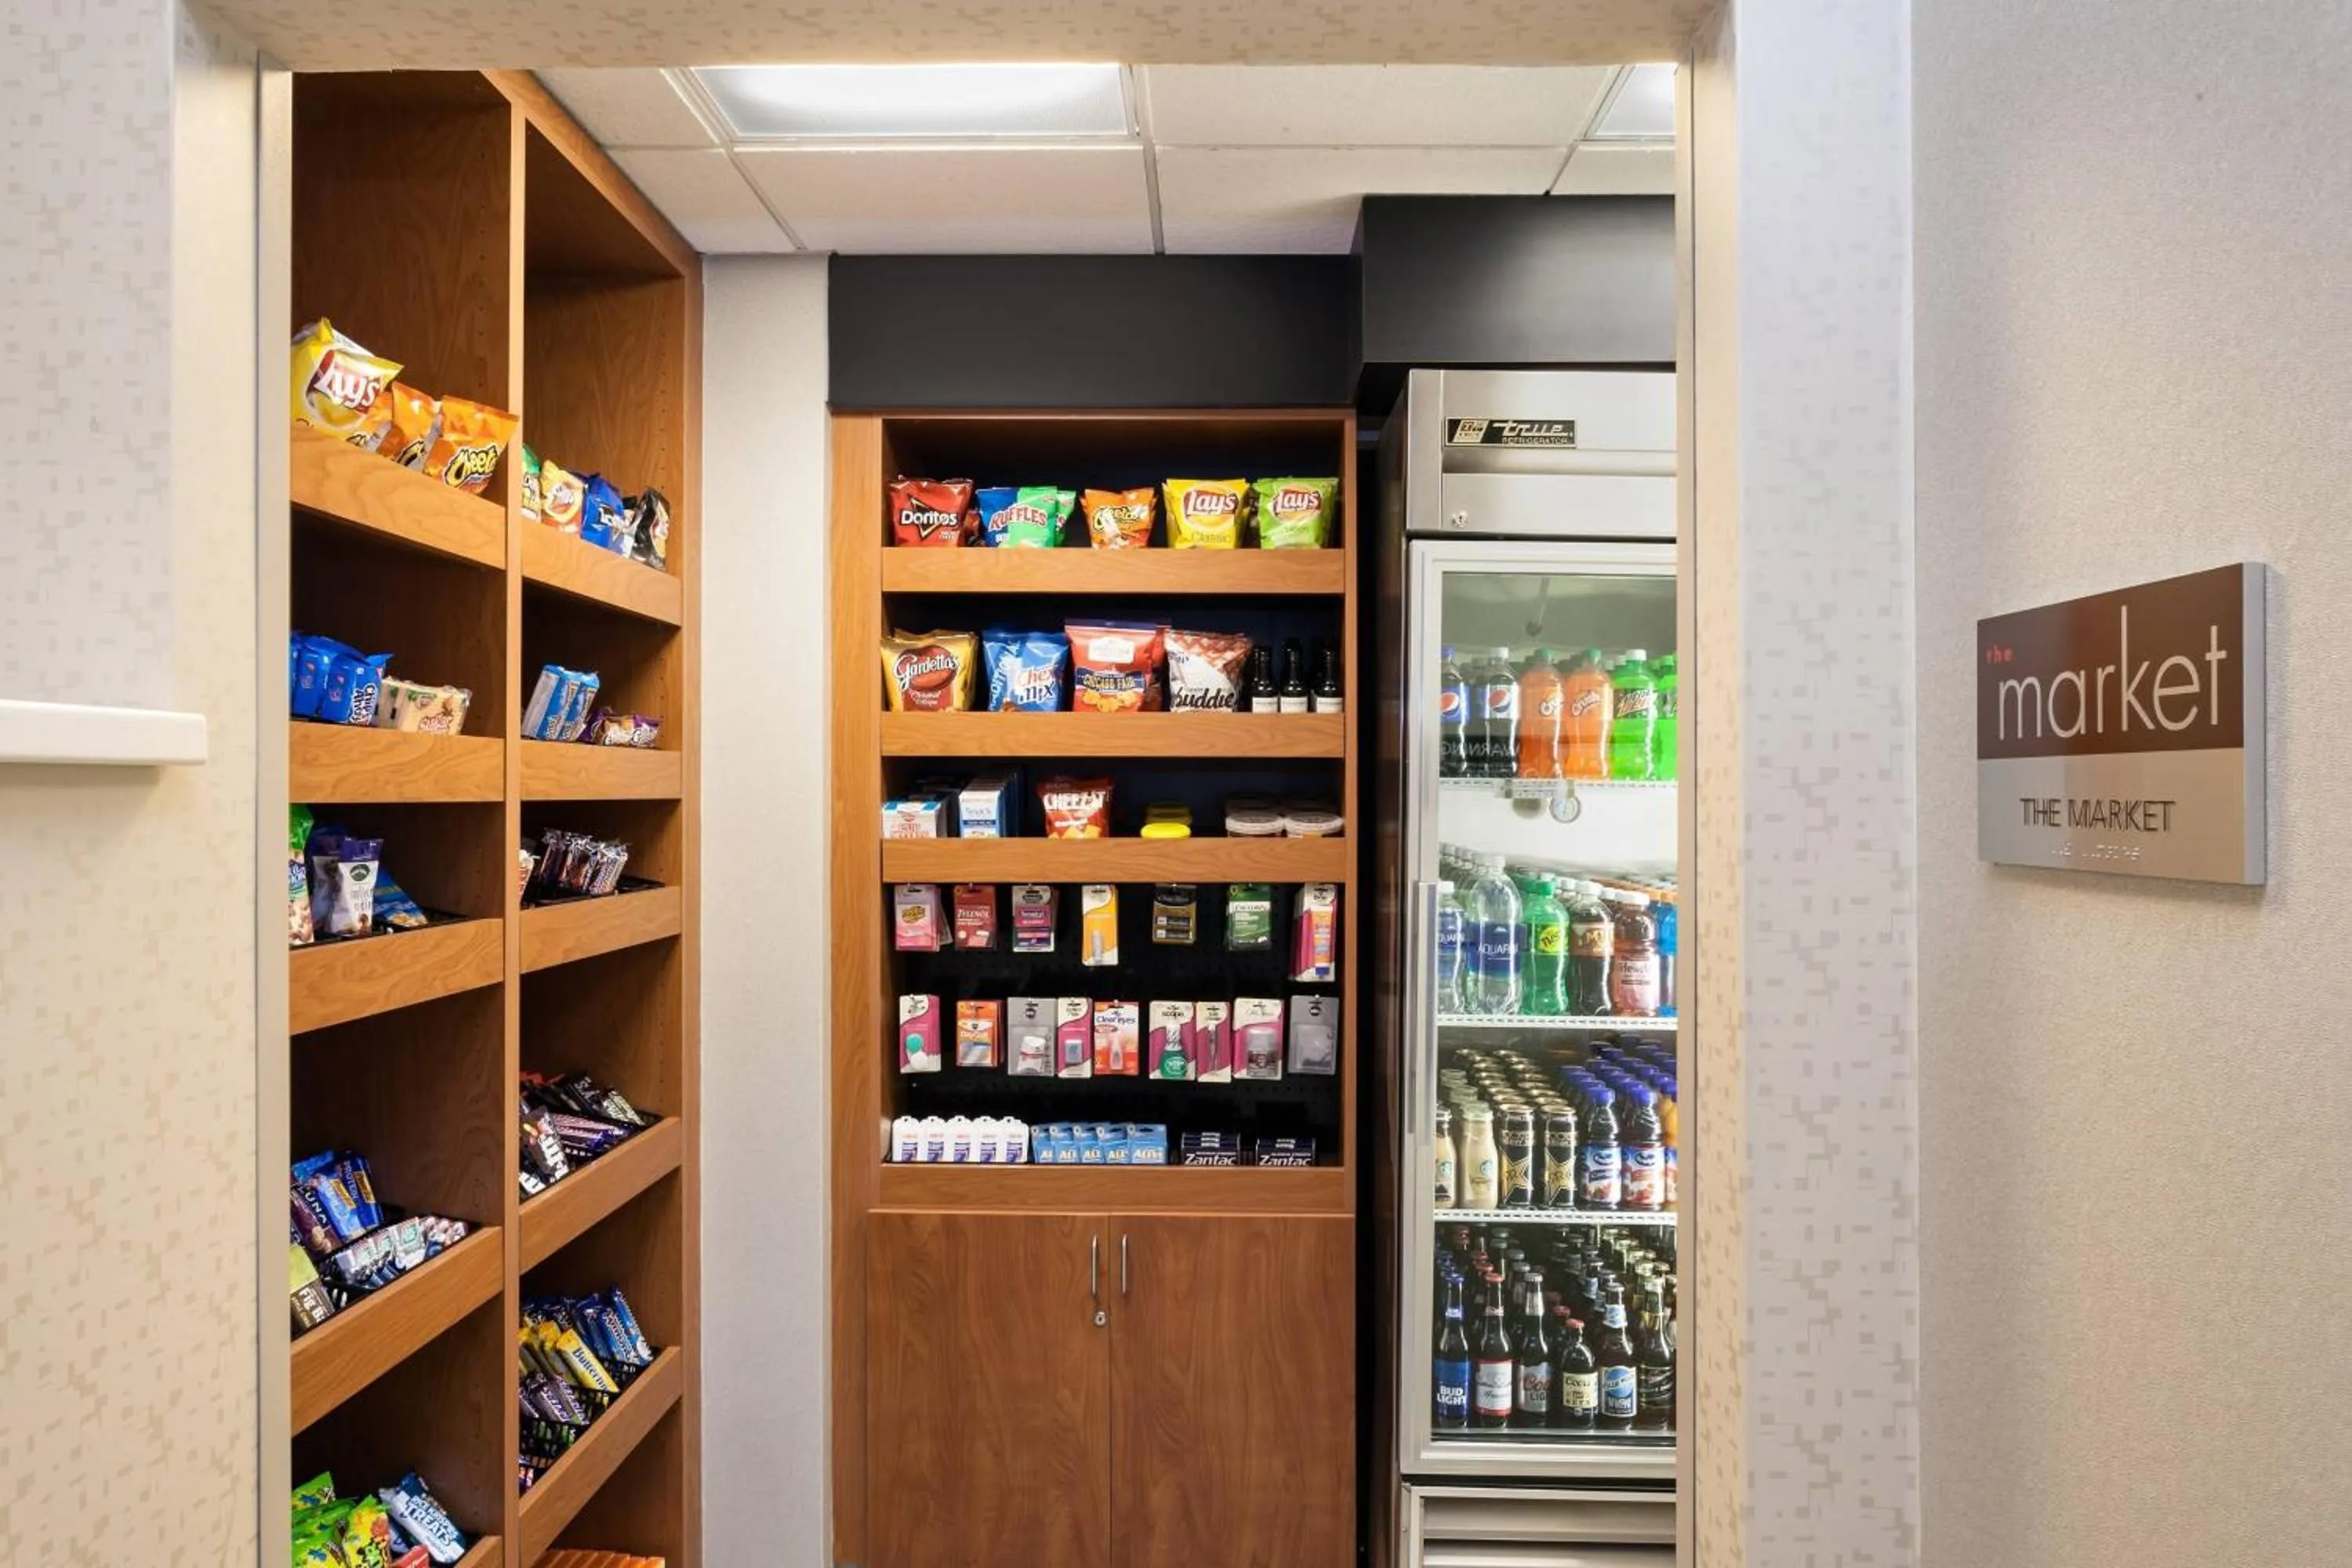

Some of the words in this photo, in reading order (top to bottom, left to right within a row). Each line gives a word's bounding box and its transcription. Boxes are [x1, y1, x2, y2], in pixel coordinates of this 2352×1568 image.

[902, 510, 958, 525] Doritos
[1985, 644, 2013, 664] the
[1998, 604, 2228, 741] market
[2019, 797, 2062, 828] THE
[2067, 798, 2176, 833] MARKET
[1185, 1153, 1237, 1166] Zantac
[1259, 1155, 1312, 1166] Zantac
[1439, 1385, 1464, 1396] BUD
[1436, 1393, 1467, 1406] LIGHT
[405, 1499, 455, 1548] TREATS
